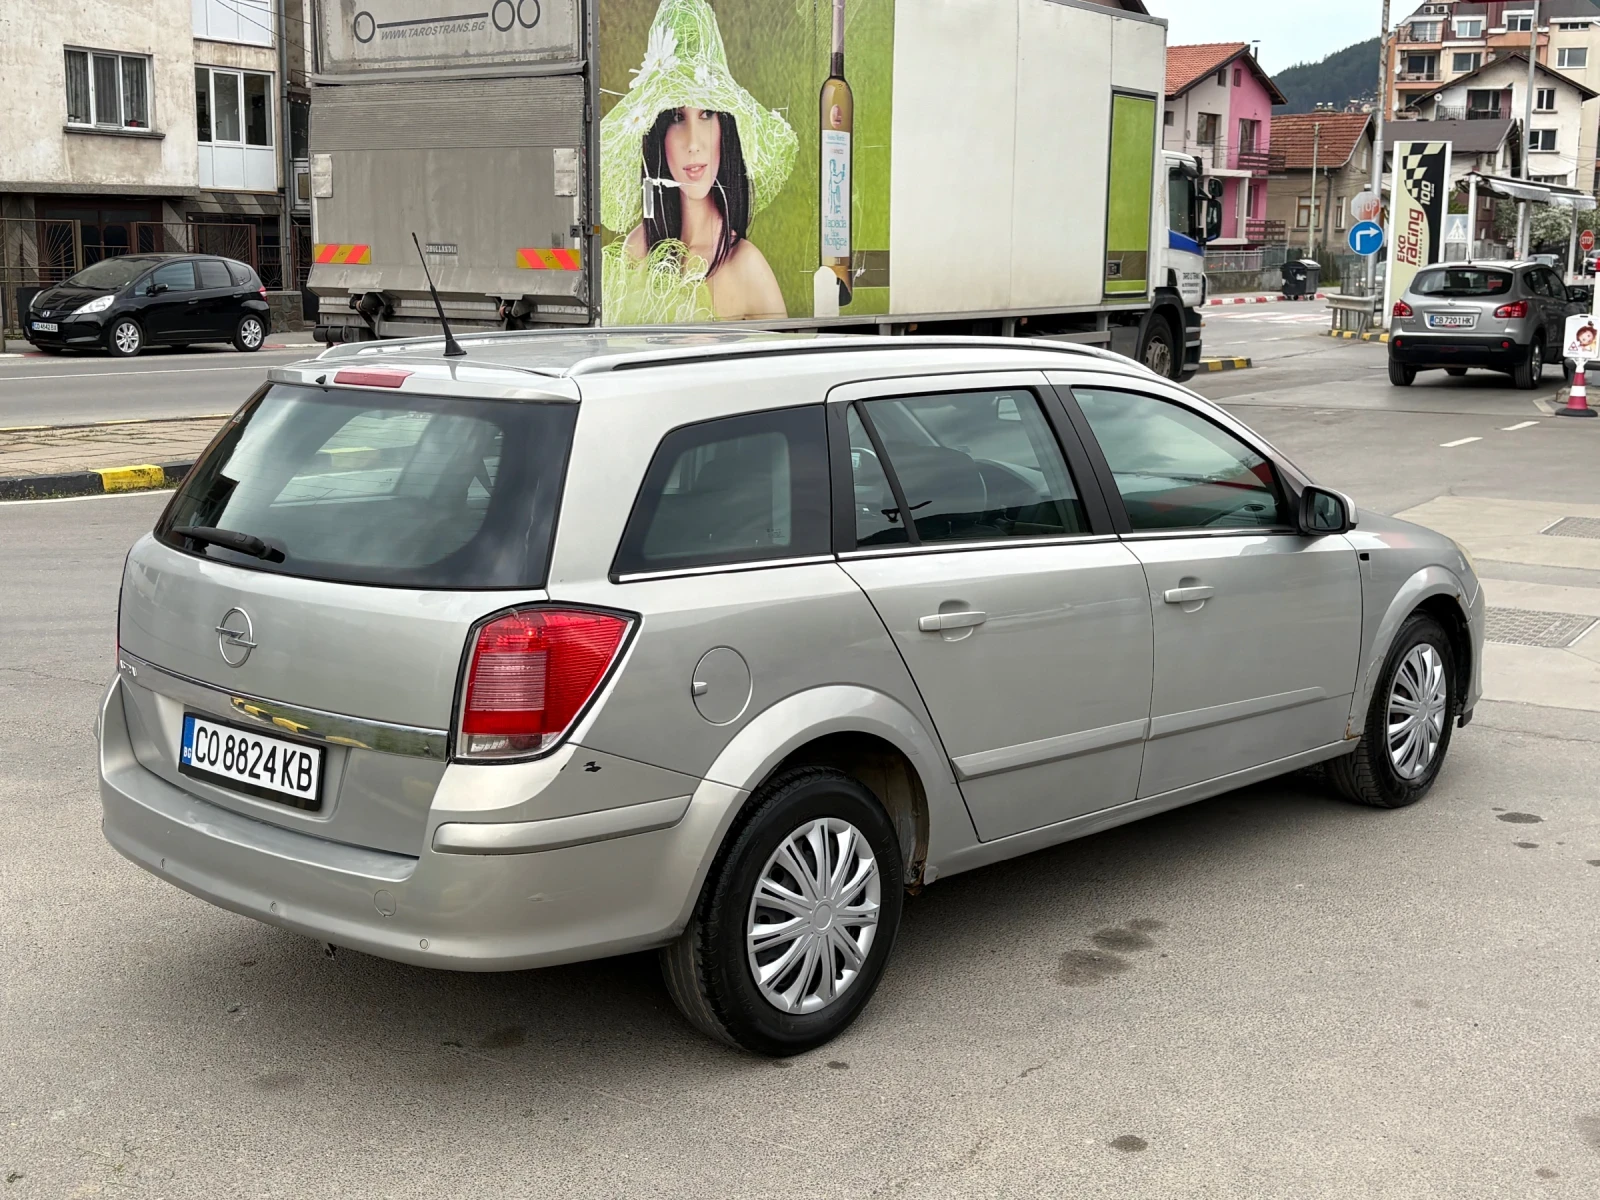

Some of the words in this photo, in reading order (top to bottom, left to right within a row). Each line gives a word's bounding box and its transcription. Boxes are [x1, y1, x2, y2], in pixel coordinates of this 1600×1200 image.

[381, 21, 486, 40] WWW.TAROSTRANS.BG
[1420, 181, 1431, 205] 100
[1406, 208, 1424, 266] racing
[1581, 236, 1592, 244] STOP
[1397, 235, 1406, 263] EKO
[183, 746, 192, 759] BG
